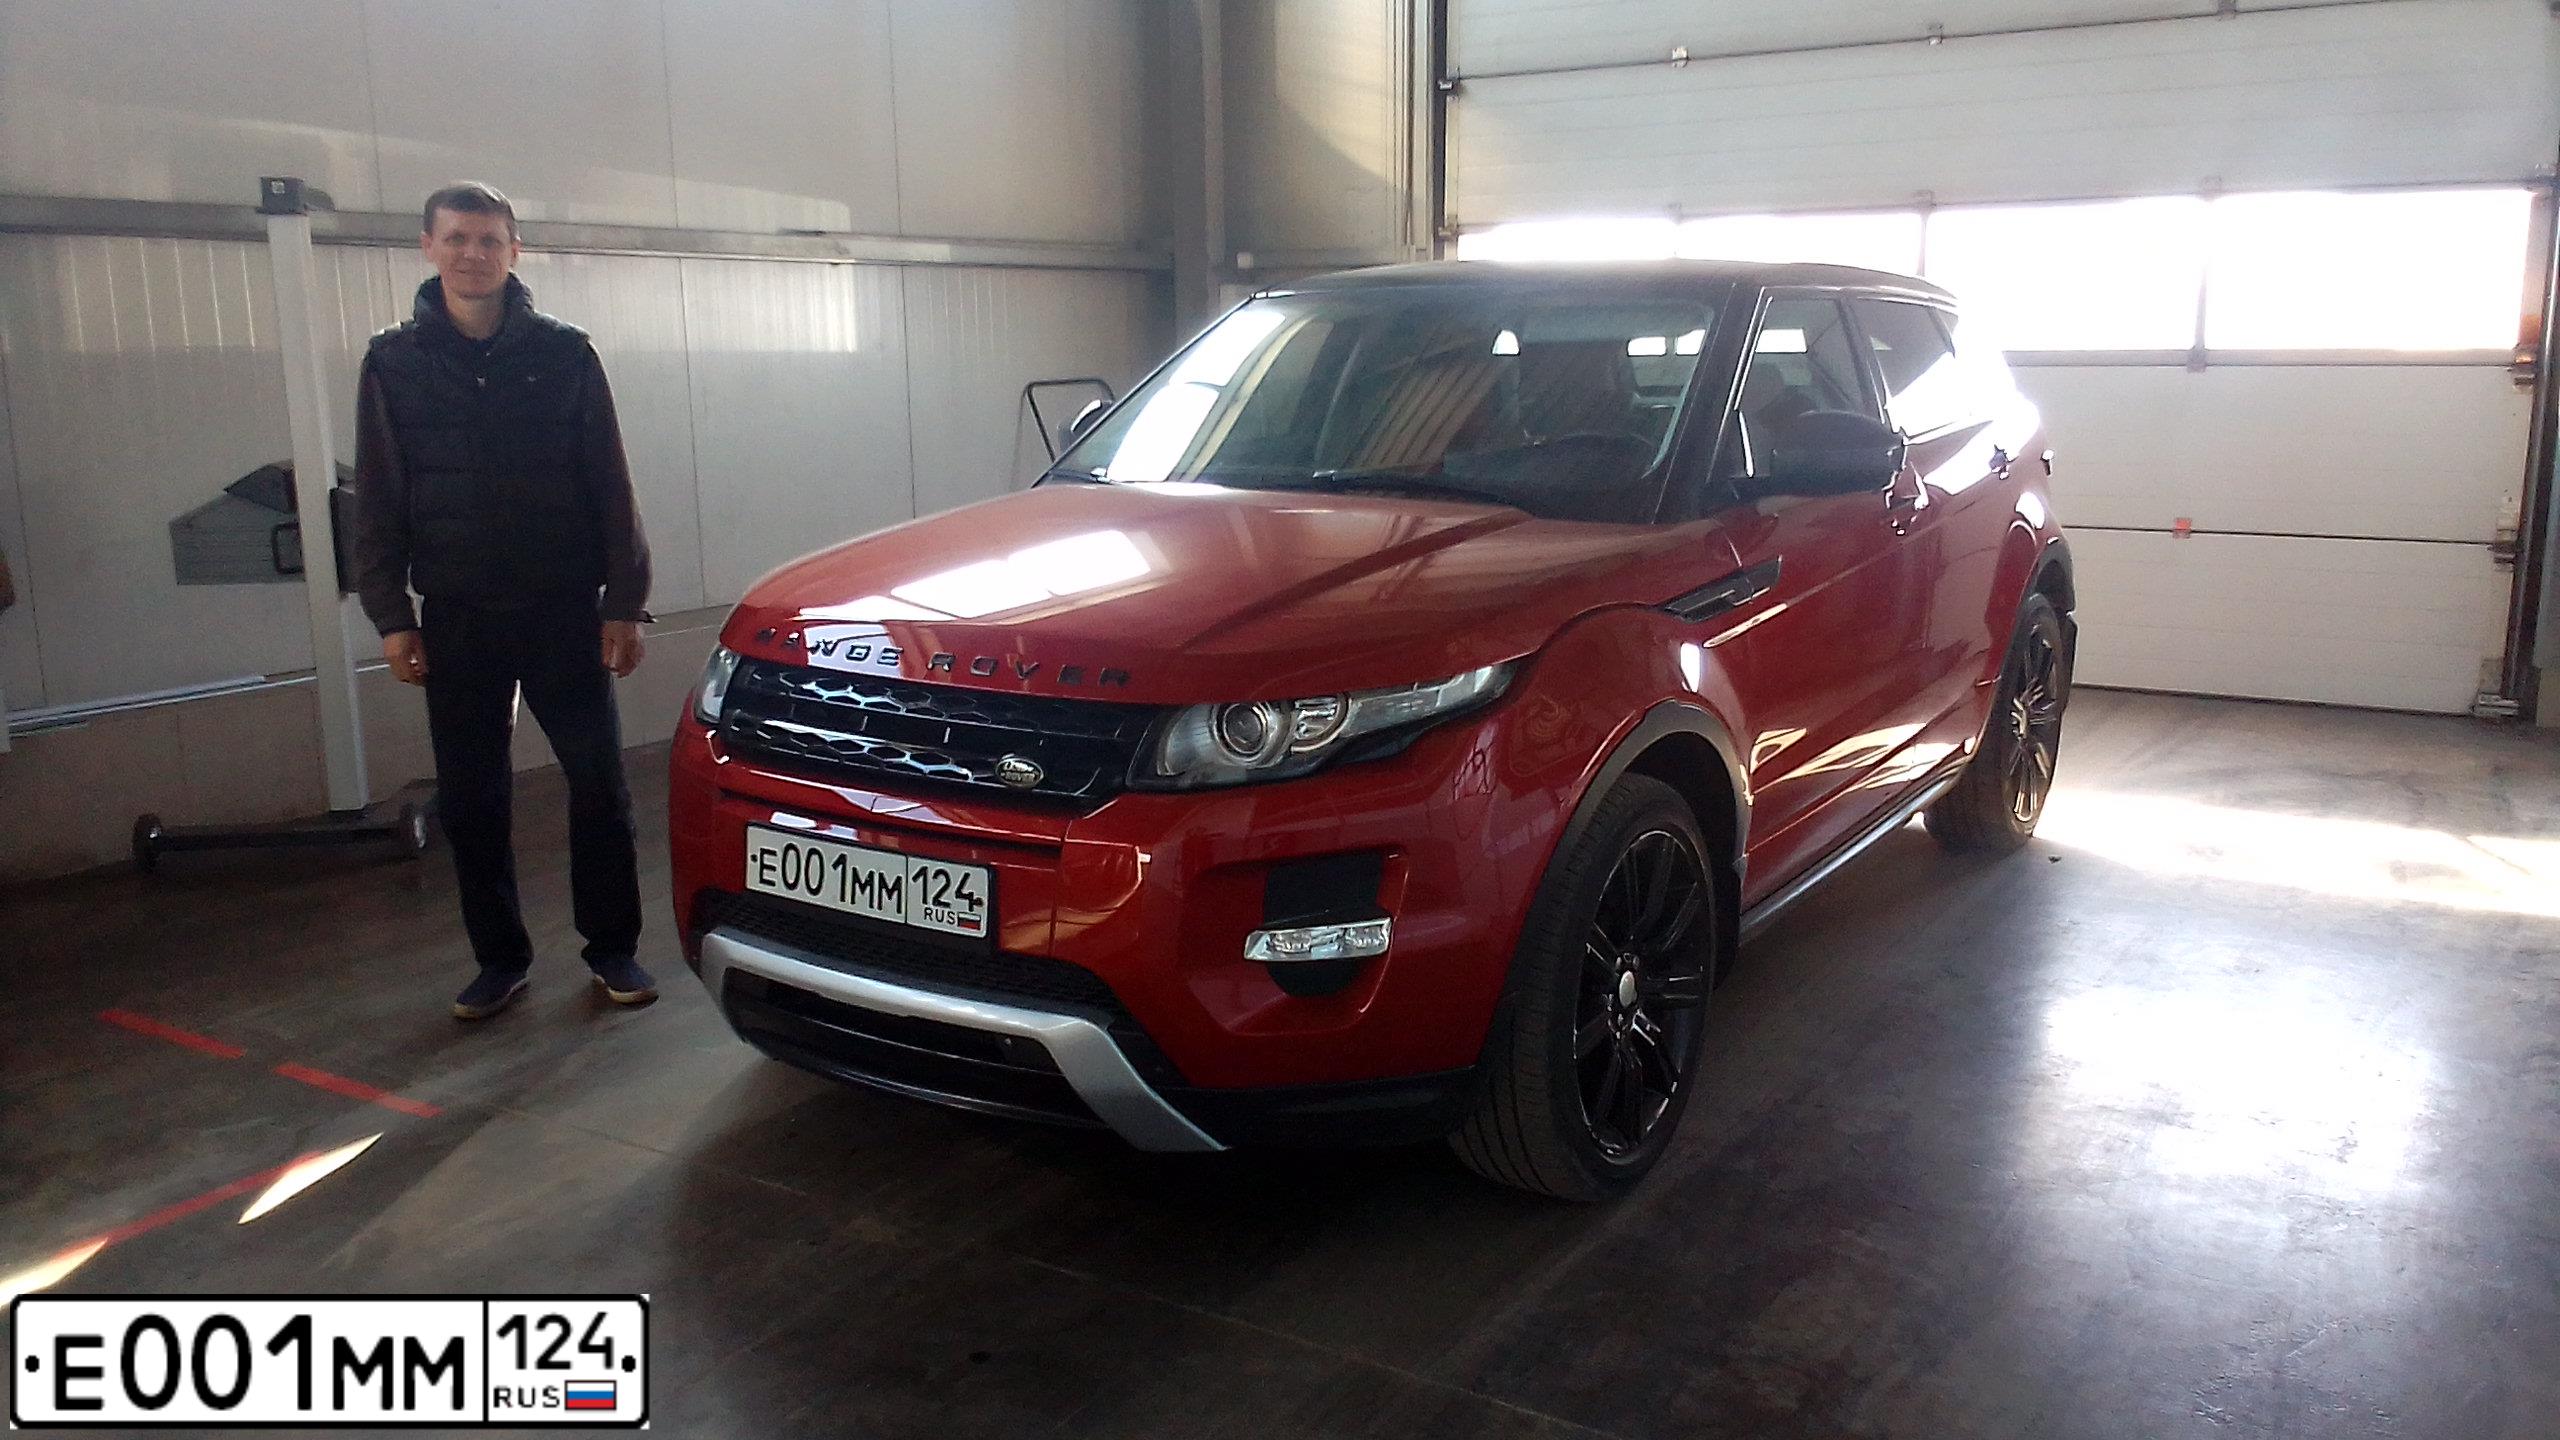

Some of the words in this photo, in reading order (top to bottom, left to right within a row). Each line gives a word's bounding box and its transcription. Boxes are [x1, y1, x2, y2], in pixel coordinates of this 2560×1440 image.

[758, 842, 903, 914] E001MM
[912, 865, 974, 911] 124
[924, 907, 956, 925] RUS
